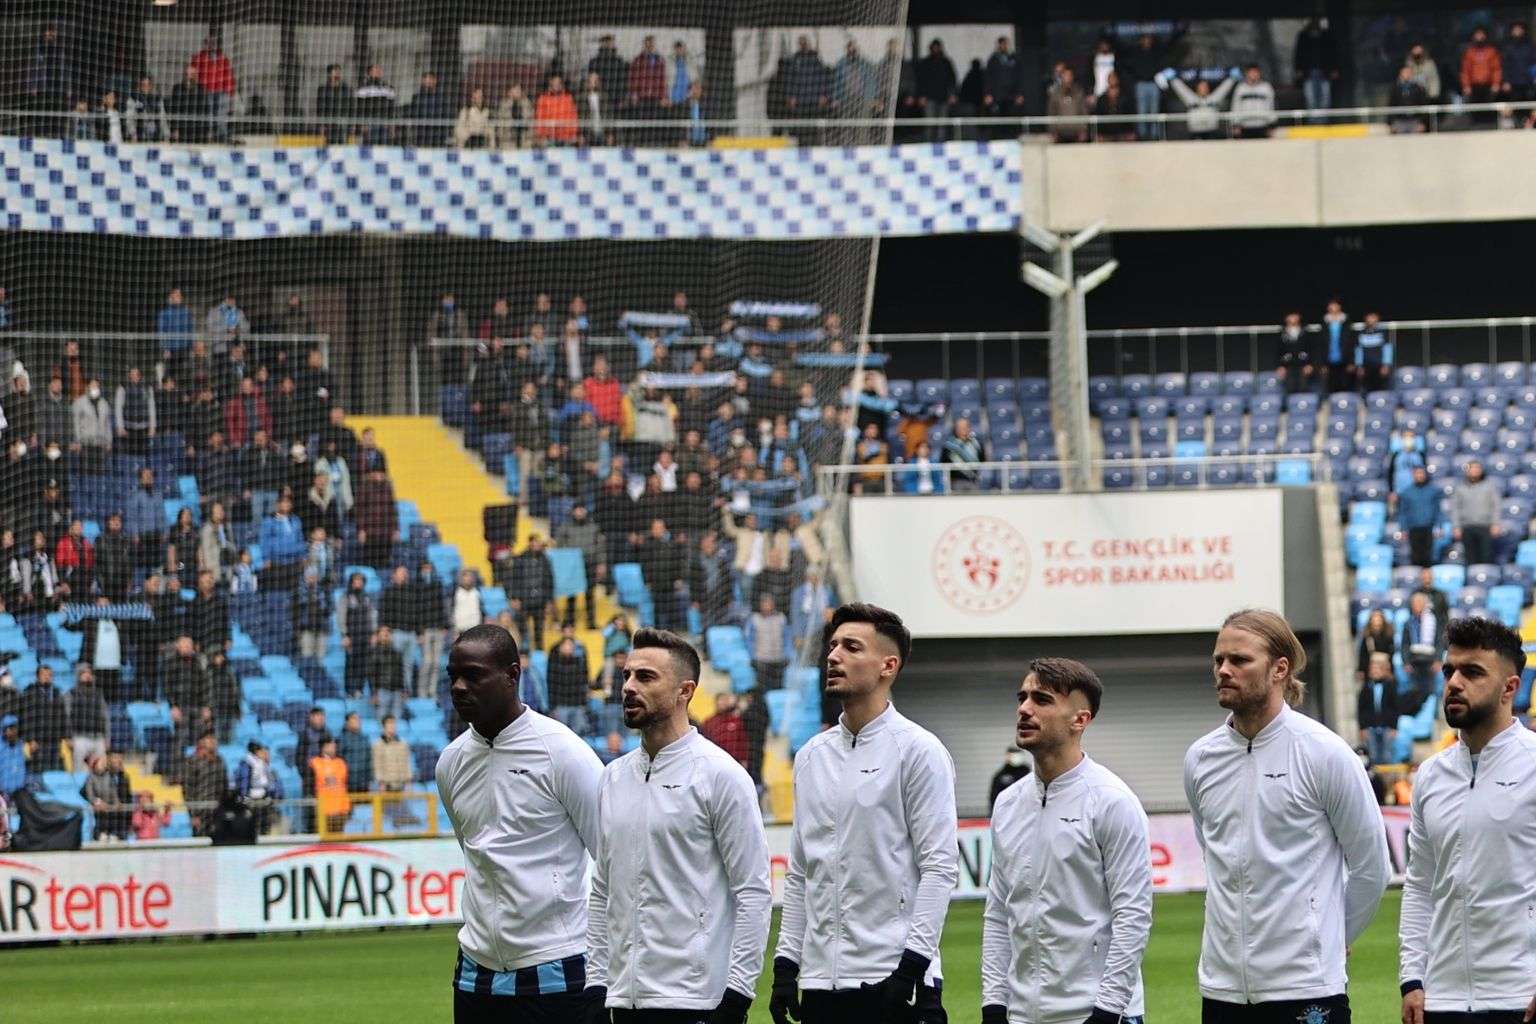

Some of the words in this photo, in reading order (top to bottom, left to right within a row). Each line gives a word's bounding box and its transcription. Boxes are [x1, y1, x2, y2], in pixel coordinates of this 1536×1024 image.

[1203, 536, 1230, 554] VE
[1043, 566, 1105, 586] SPOR
[1109, 561, 1235, 584] BAKANLIĞI
[45, 873, 172, 932] tente
[262, 863, 397, 922] PINAR
